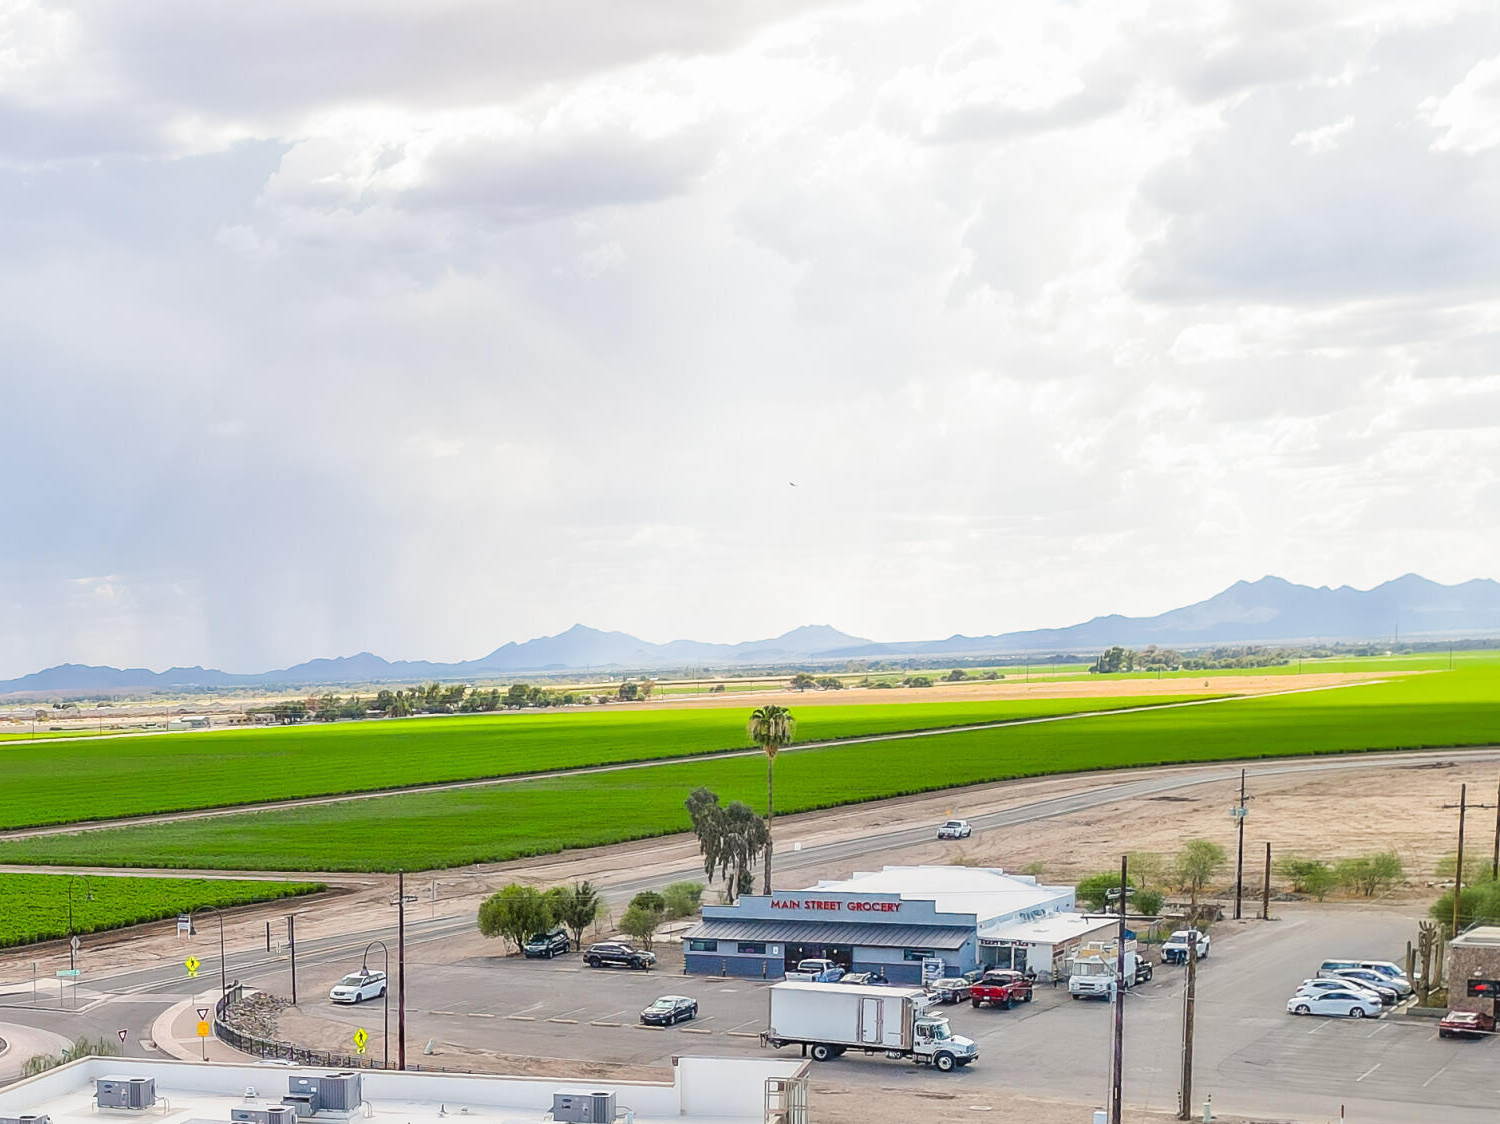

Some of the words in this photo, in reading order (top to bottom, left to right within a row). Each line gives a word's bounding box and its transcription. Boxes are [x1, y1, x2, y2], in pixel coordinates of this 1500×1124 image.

[771, 899, 800, 909] MAIN
[804, 900, 842, 911] STREET
[847, 901, 901, 912] GROCERY
